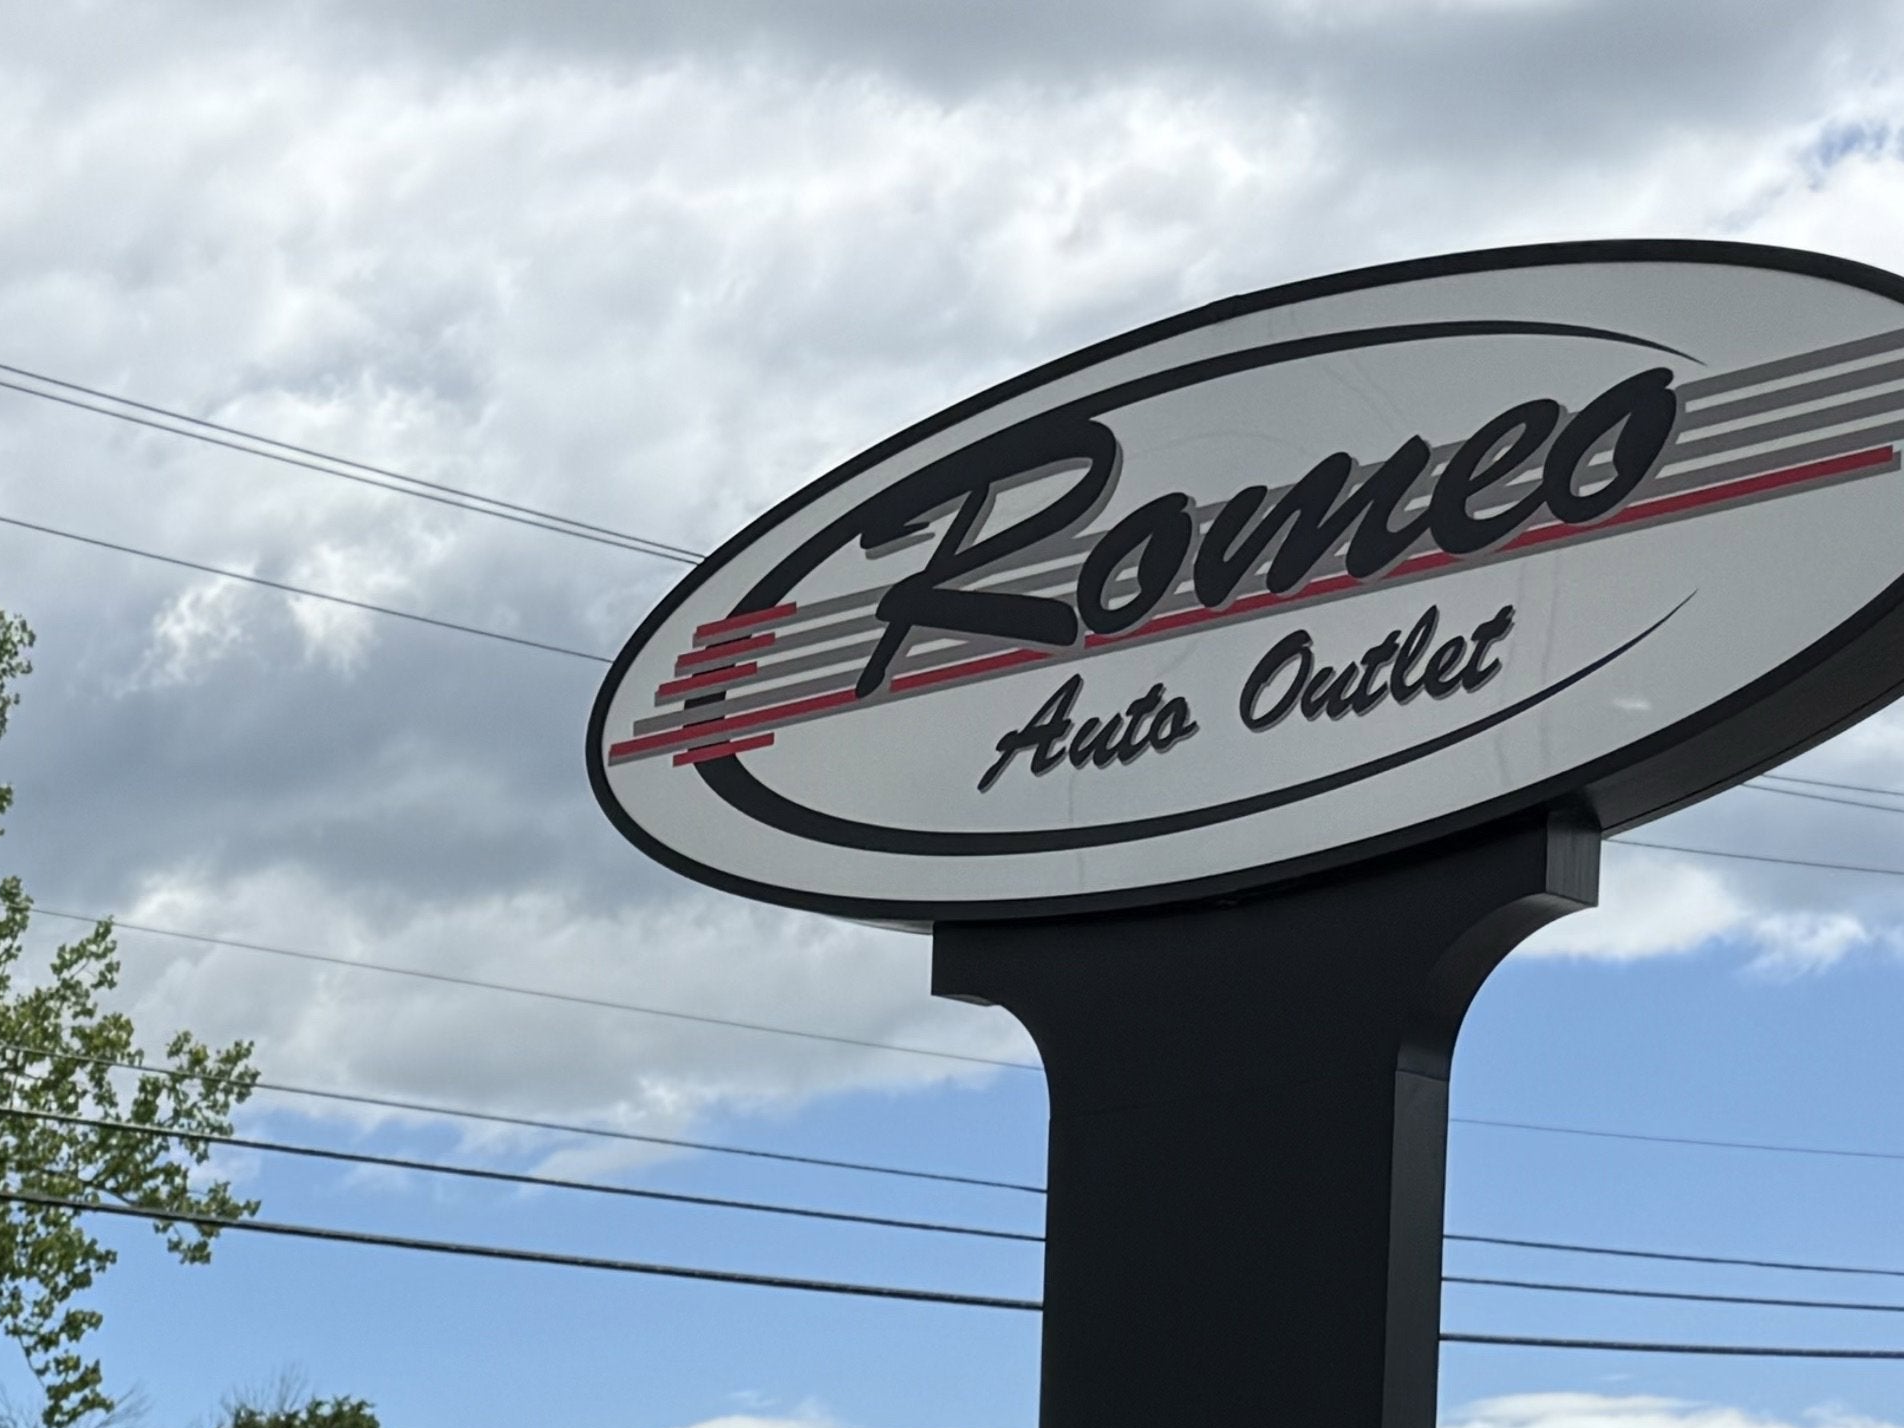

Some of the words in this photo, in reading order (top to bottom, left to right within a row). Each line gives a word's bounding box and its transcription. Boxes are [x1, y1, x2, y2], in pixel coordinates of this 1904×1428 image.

[853, 366, 1680, 700] Romeo
[978, 672, 1198, 794] Auto
[1239, 603, 1517, 734] Outlet
